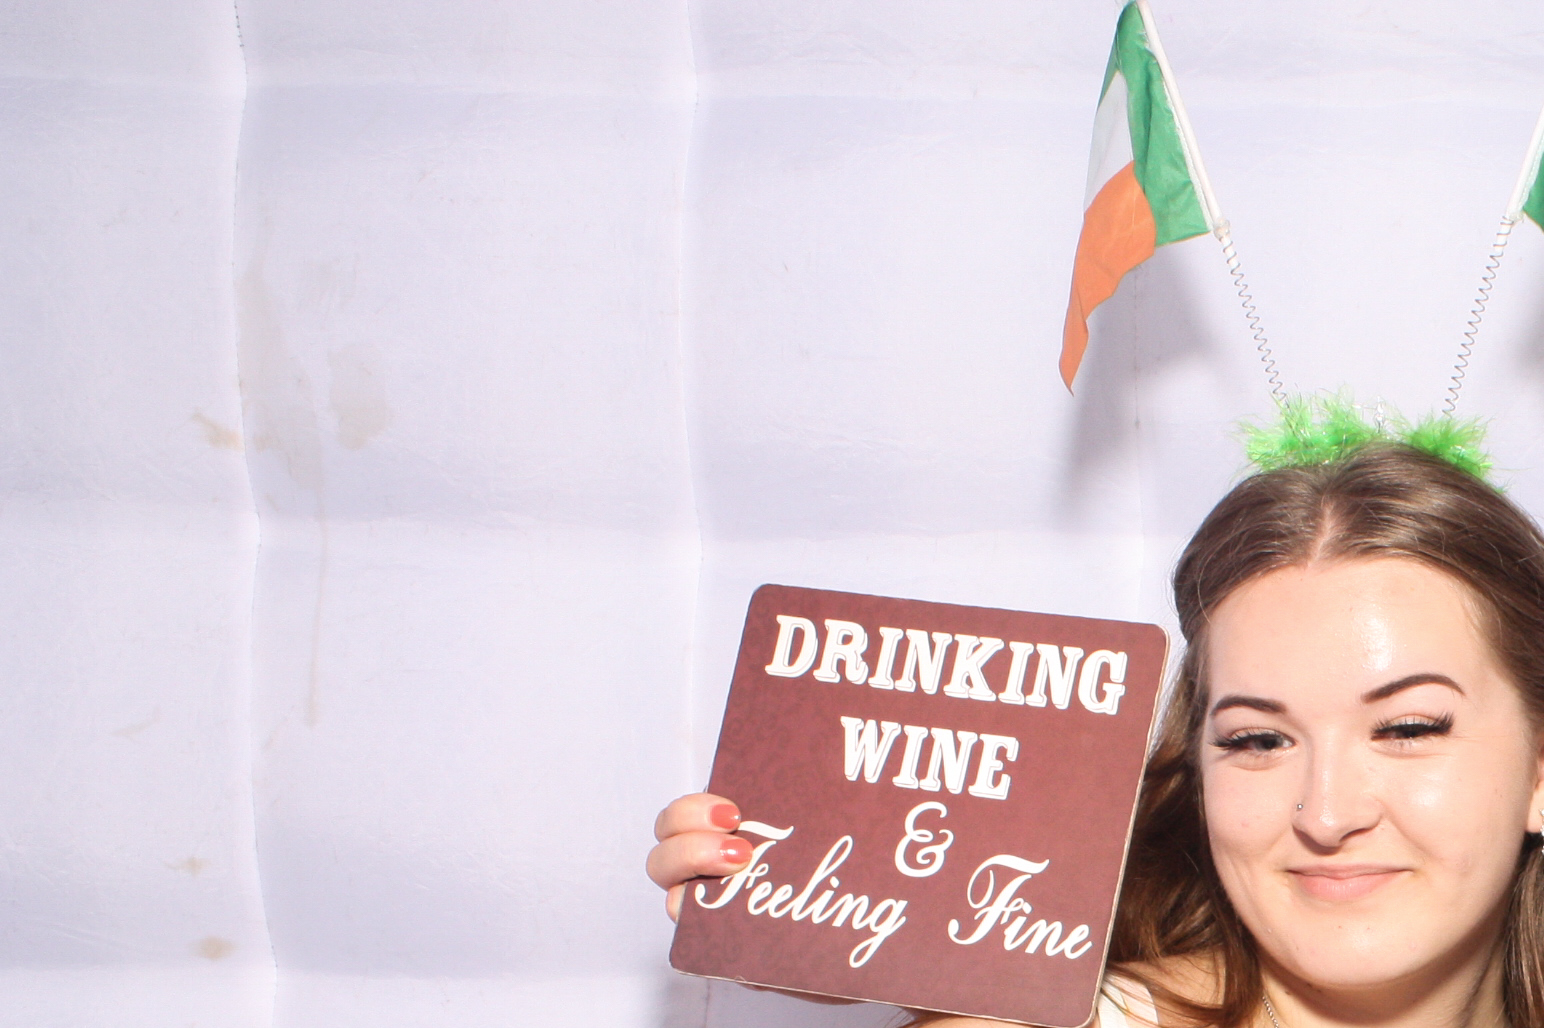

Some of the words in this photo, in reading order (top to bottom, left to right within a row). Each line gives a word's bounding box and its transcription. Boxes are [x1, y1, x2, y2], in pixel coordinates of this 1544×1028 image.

[765, 615, 1127, 715] DRINKING
[840, 716, 1018, 800] WINE
[894, 801, 954, 877] &
[694, 820, 908, 968] Feeling
[947, 854, 1092, 959] Fine
